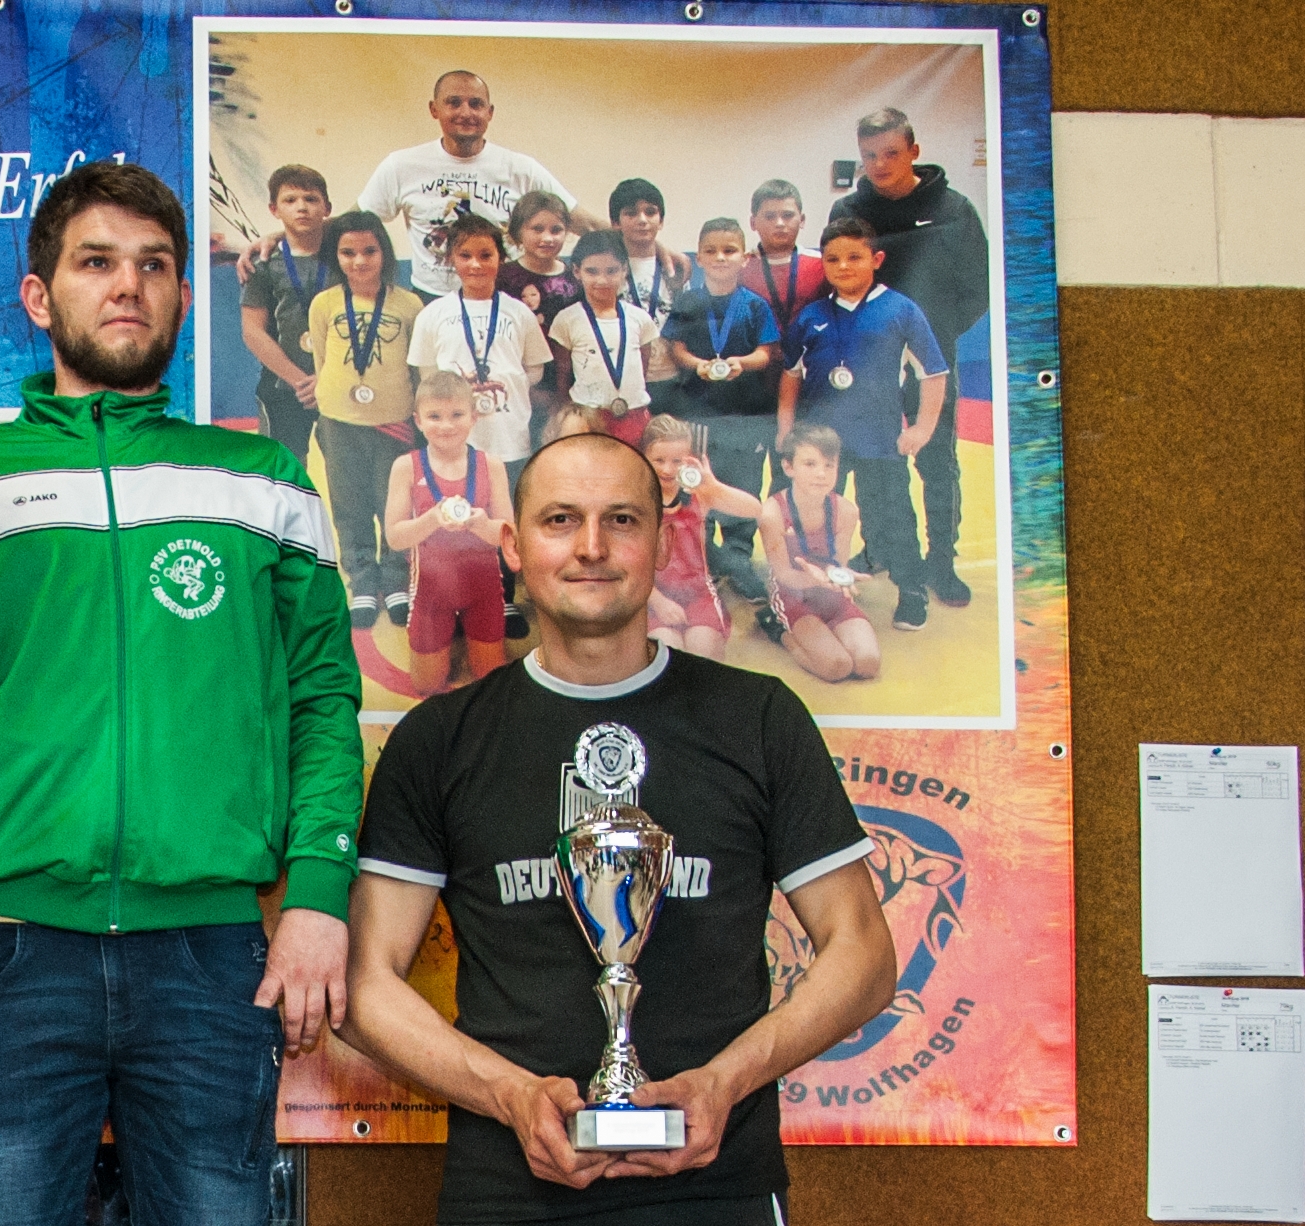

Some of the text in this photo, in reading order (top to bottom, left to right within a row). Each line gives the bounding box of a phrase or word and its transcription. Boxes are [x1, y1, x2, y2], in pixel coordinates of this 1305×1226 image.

[29, 493, 58, 502] JAKO
[150, 538, 222, 571] PSV DETMOLD
[816, 997, 976, 1107] Wolfhagen
[284, 1102, 350, 1114] gesponsert
[353, 1102, 387, 1112] durch
